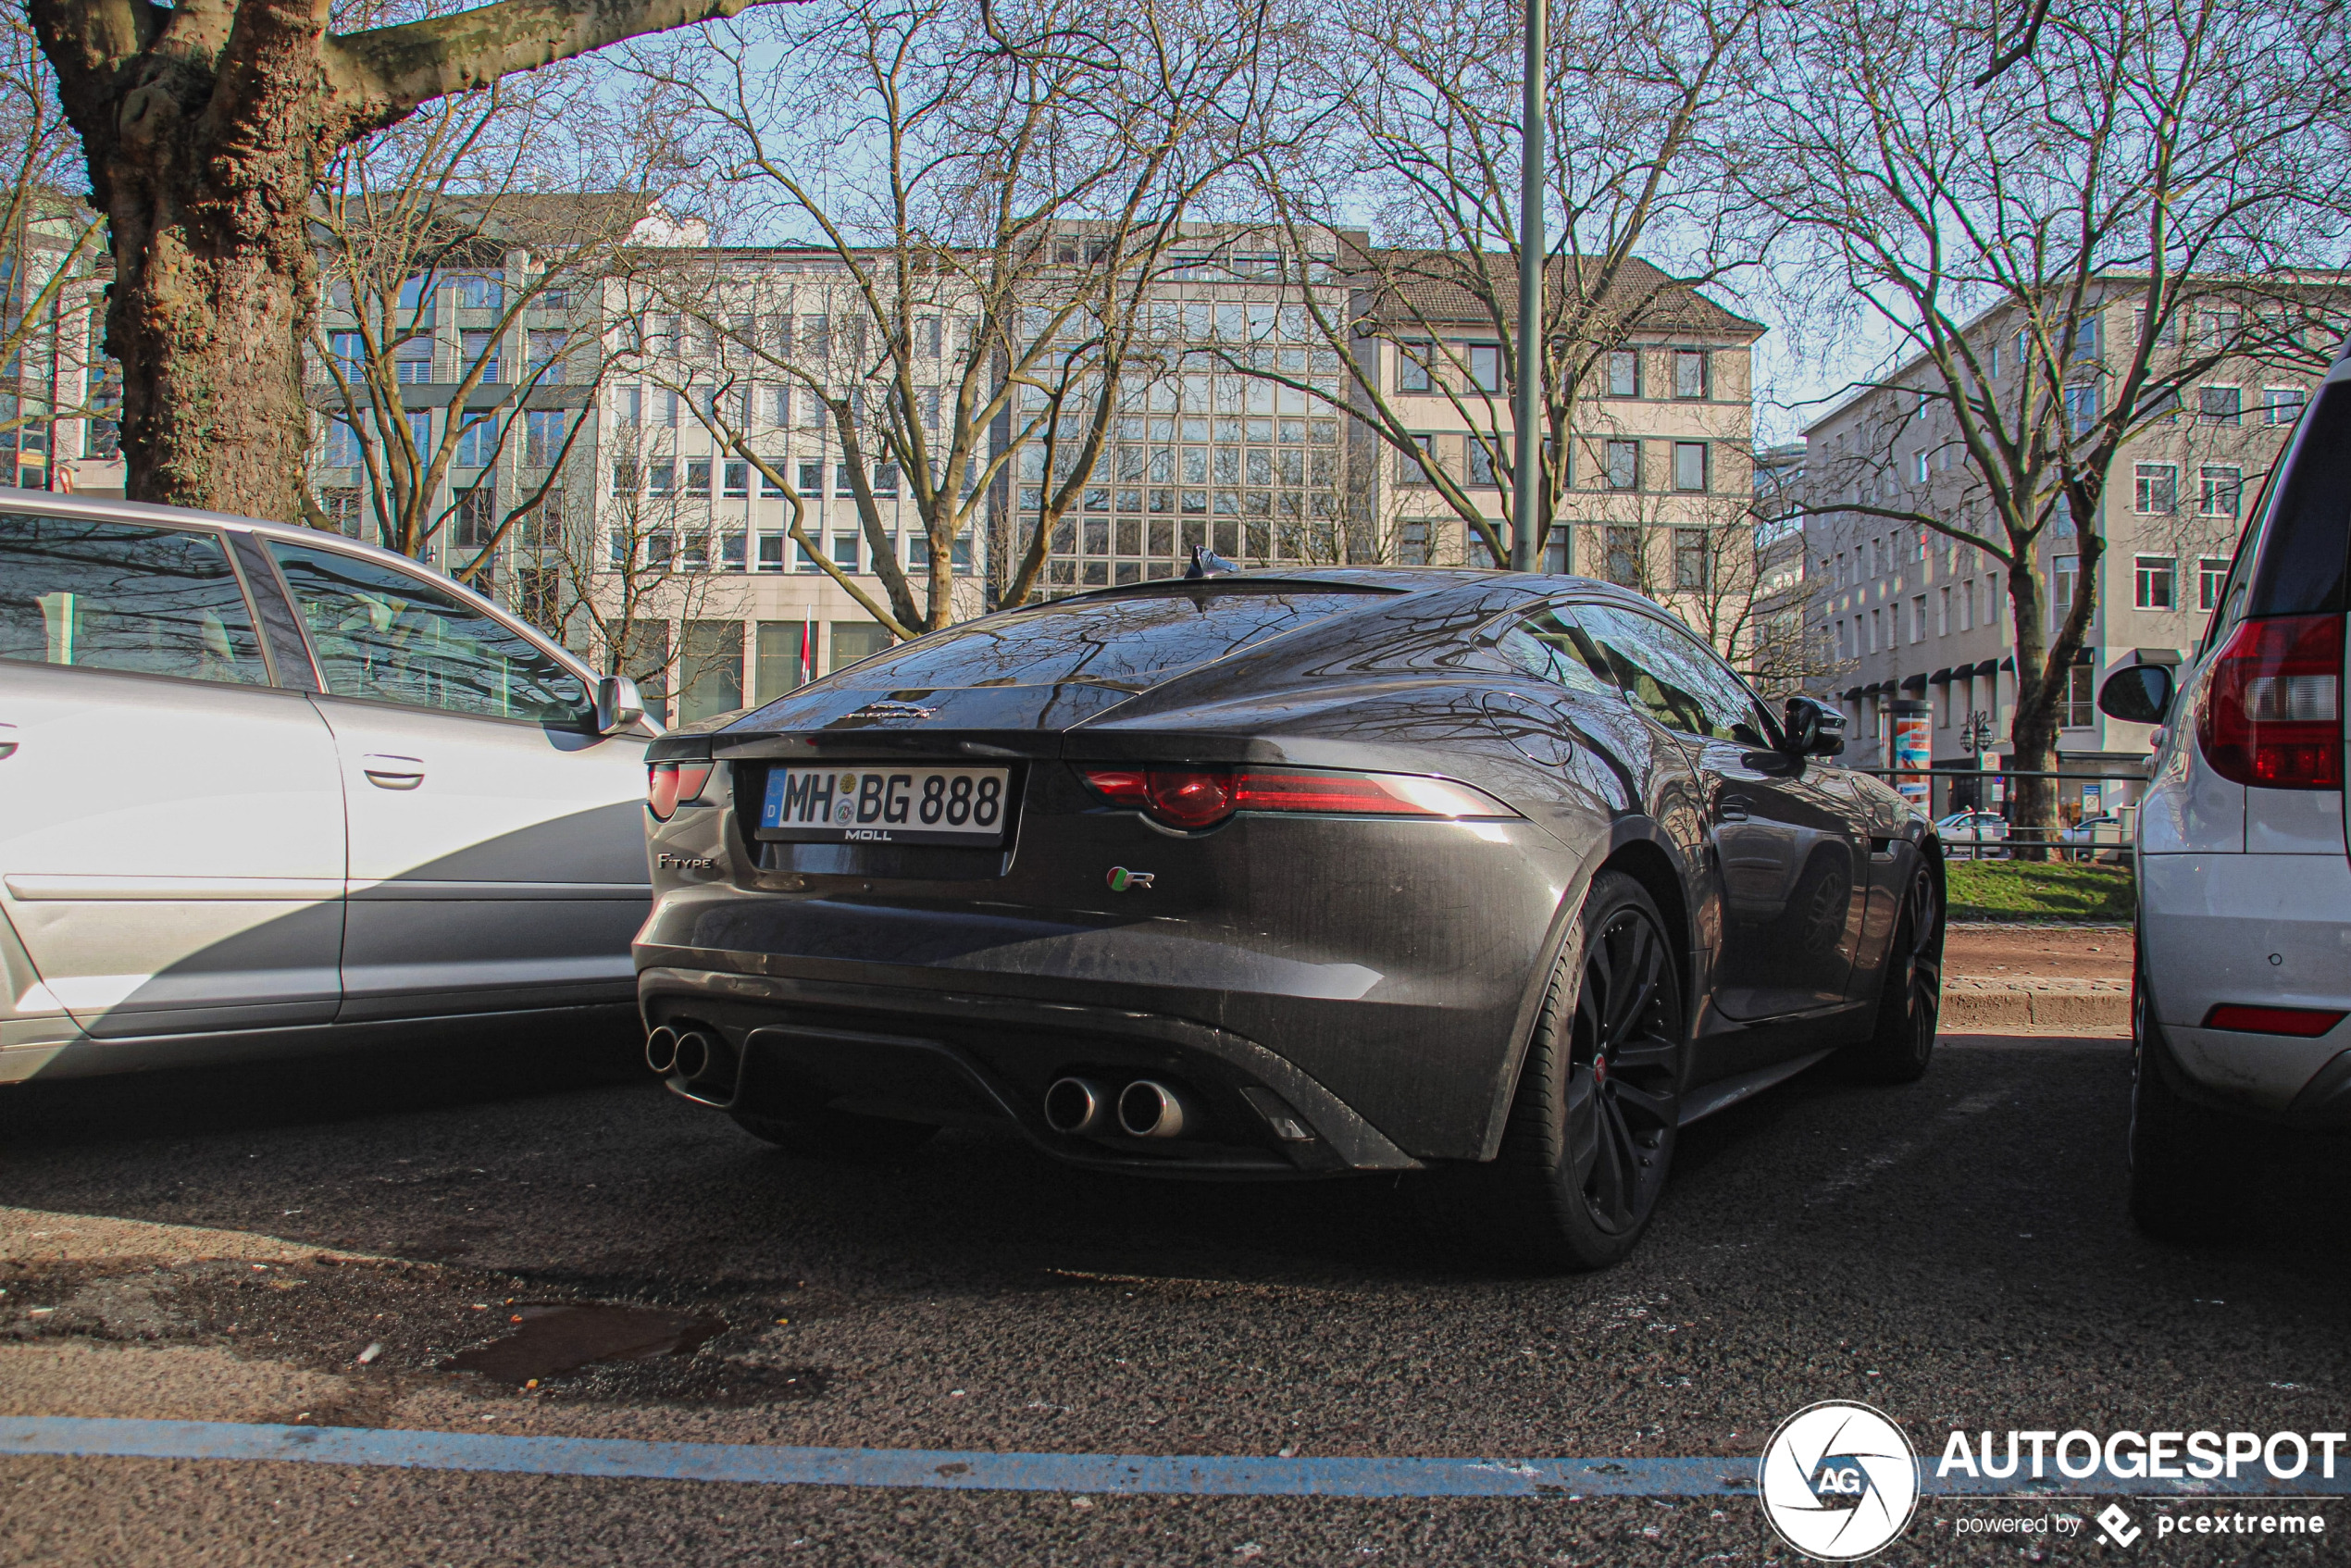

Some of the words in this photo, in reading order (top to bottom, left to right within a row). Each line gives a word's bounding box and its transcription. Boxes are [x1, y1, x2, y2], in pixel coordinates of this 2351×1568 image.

[783, 774, 836, 822] MH
[856, 774, 912, 824] BG
[919, 775, 1001, 827] 888
[767, 804, 776, 817] D
[845, 829, 892, 840] MOLL
[1122, 872, 1155, 889] R
